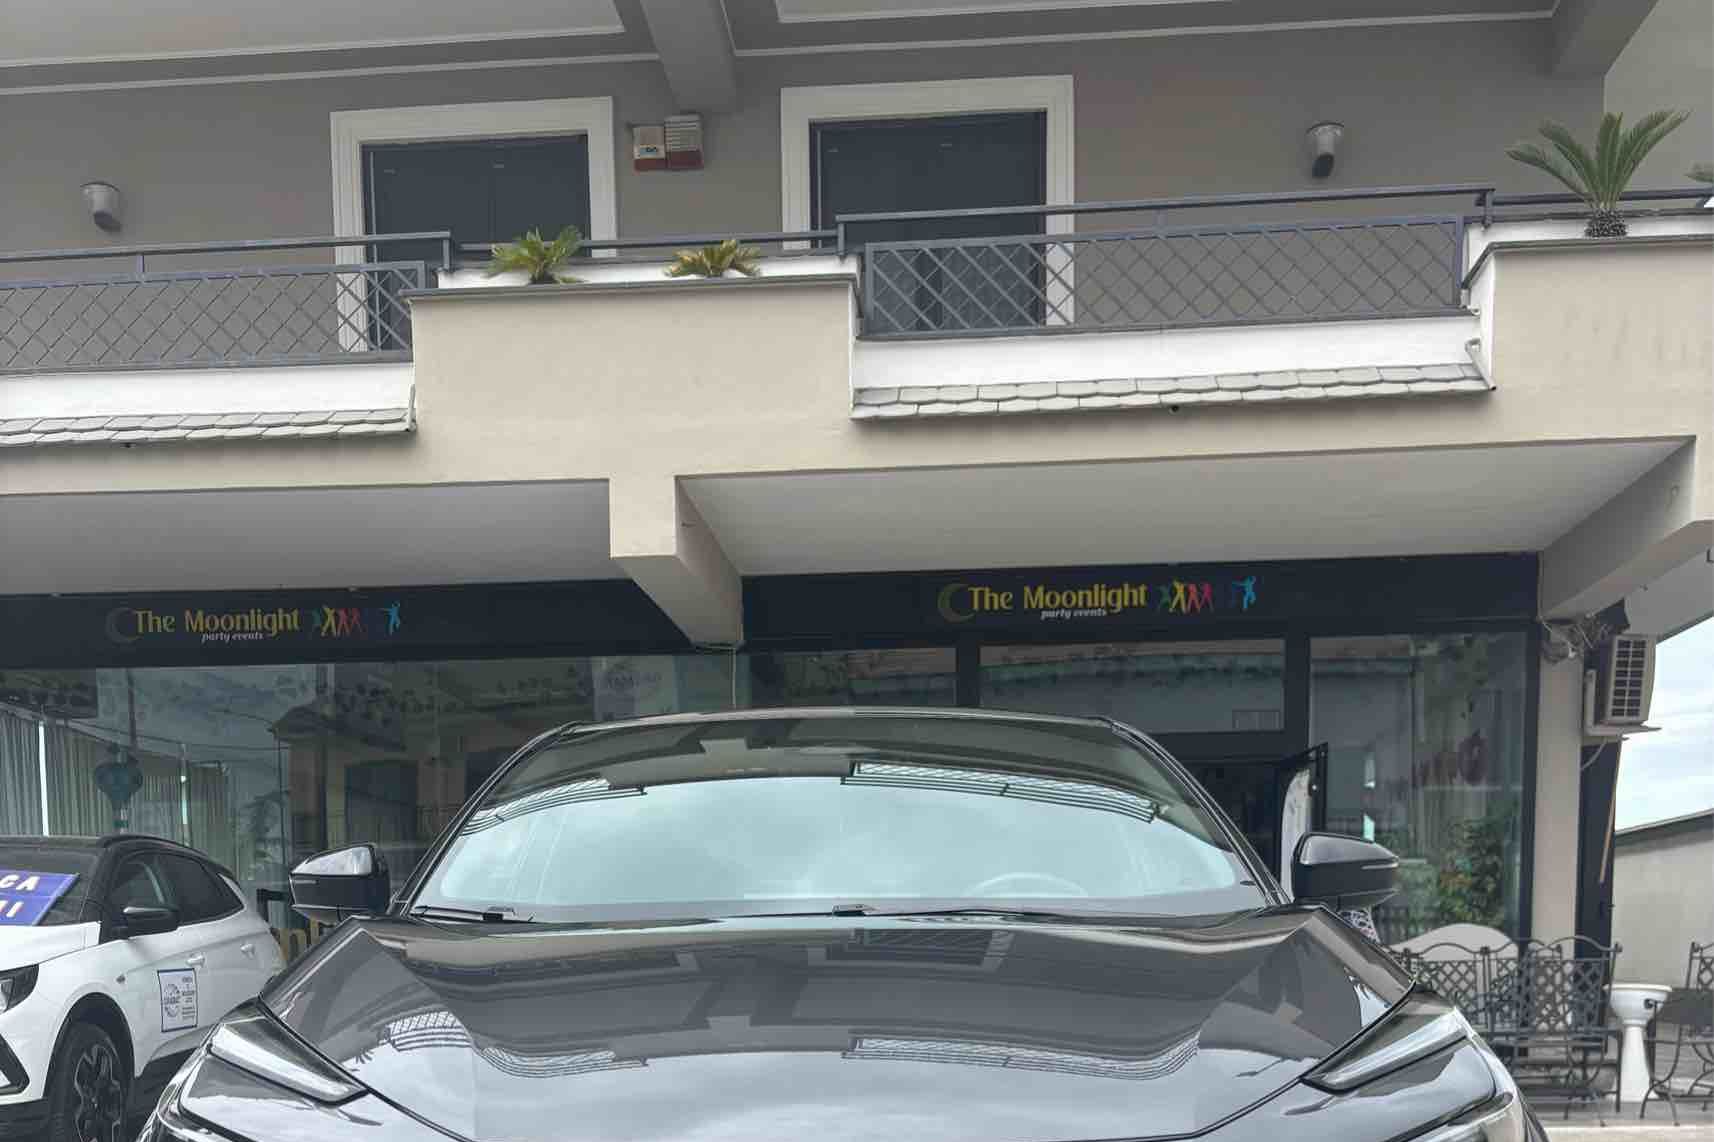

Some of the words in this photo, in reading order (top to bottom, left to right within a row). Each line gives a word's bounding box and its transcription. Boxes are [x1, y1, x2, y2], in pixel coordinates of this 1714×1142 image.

[967, 585, 1014, 611] The
[1023, 582, 1149, 613] Moonlight
[134, 609, 176, 634] The
[184, 607, 300, 636] Moonlight
[1040, 608, 1072, 621] party
[1073, 607, 1107, 619] events
[200, 631, 230, 643] party
[231, 630, 264, 642] events
